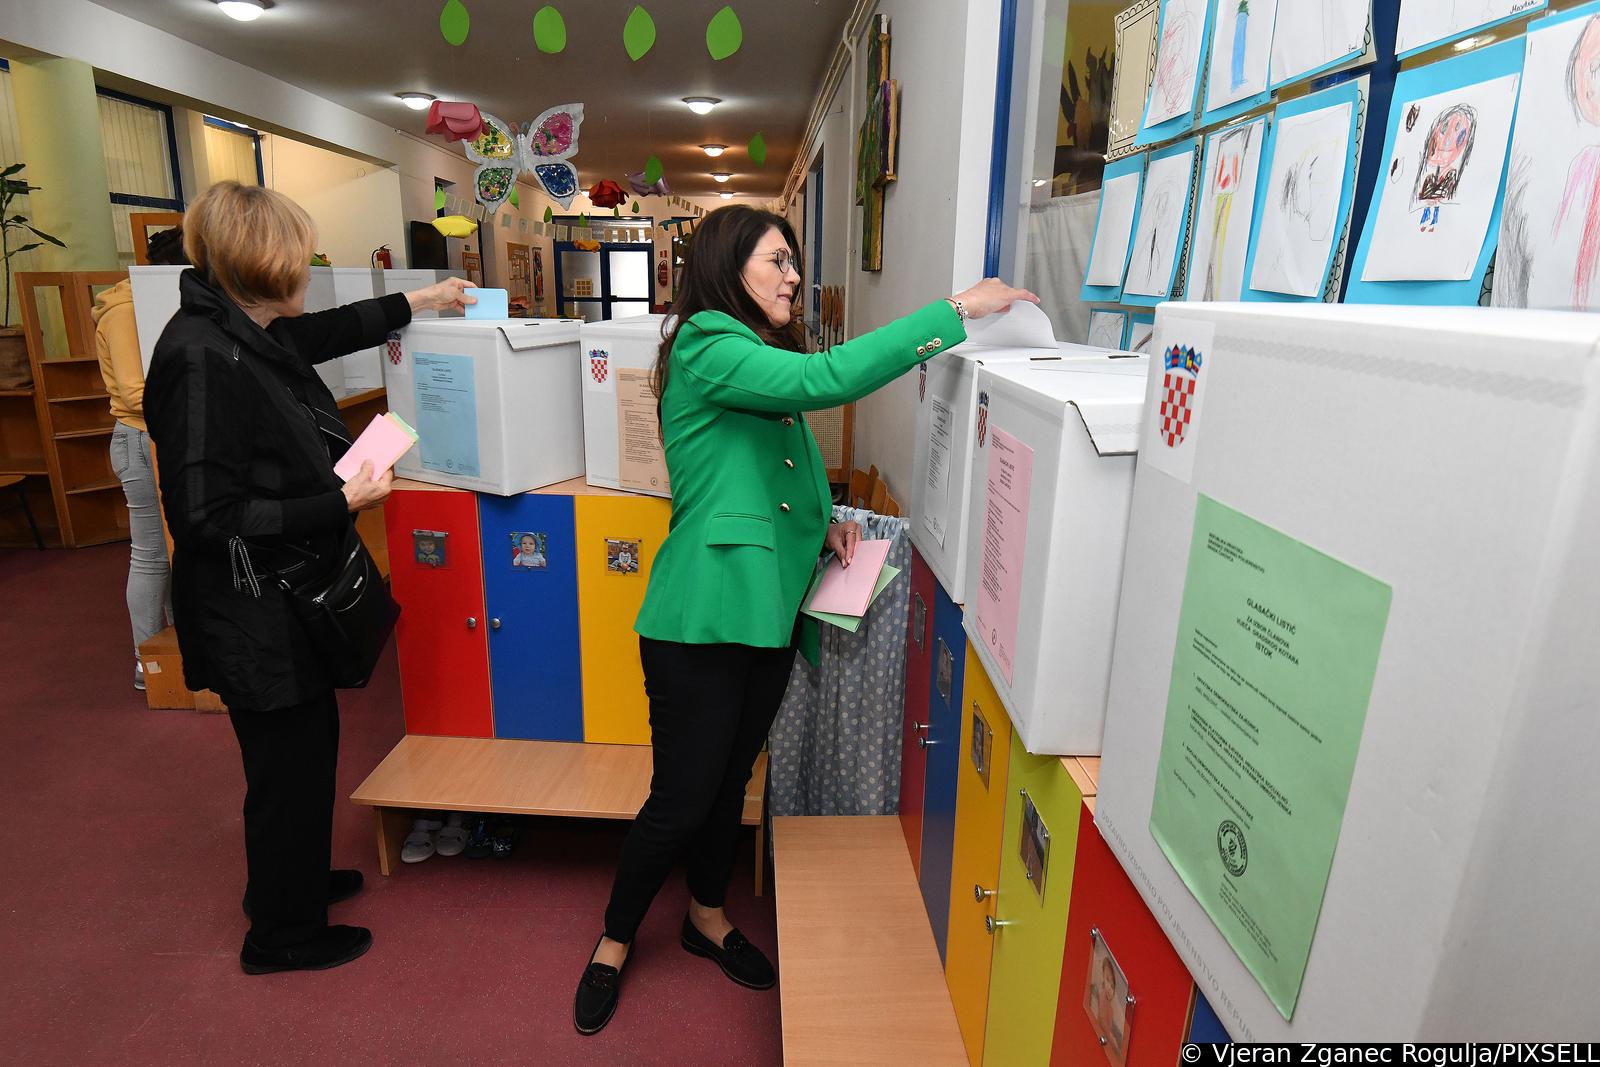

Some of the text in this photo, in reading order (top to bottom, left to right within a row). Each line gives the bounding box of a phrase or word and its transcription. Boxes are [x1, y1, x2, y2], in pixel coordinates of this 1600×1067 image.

[1246, 598, 1296, 635] GLASAČKI LISTIĆ
[1252, 629, 1278, 652] GRADSKOG
[1278, 647, 1298, 666] KOTARA
[1255, 641, 1273, 660] ISTOK
